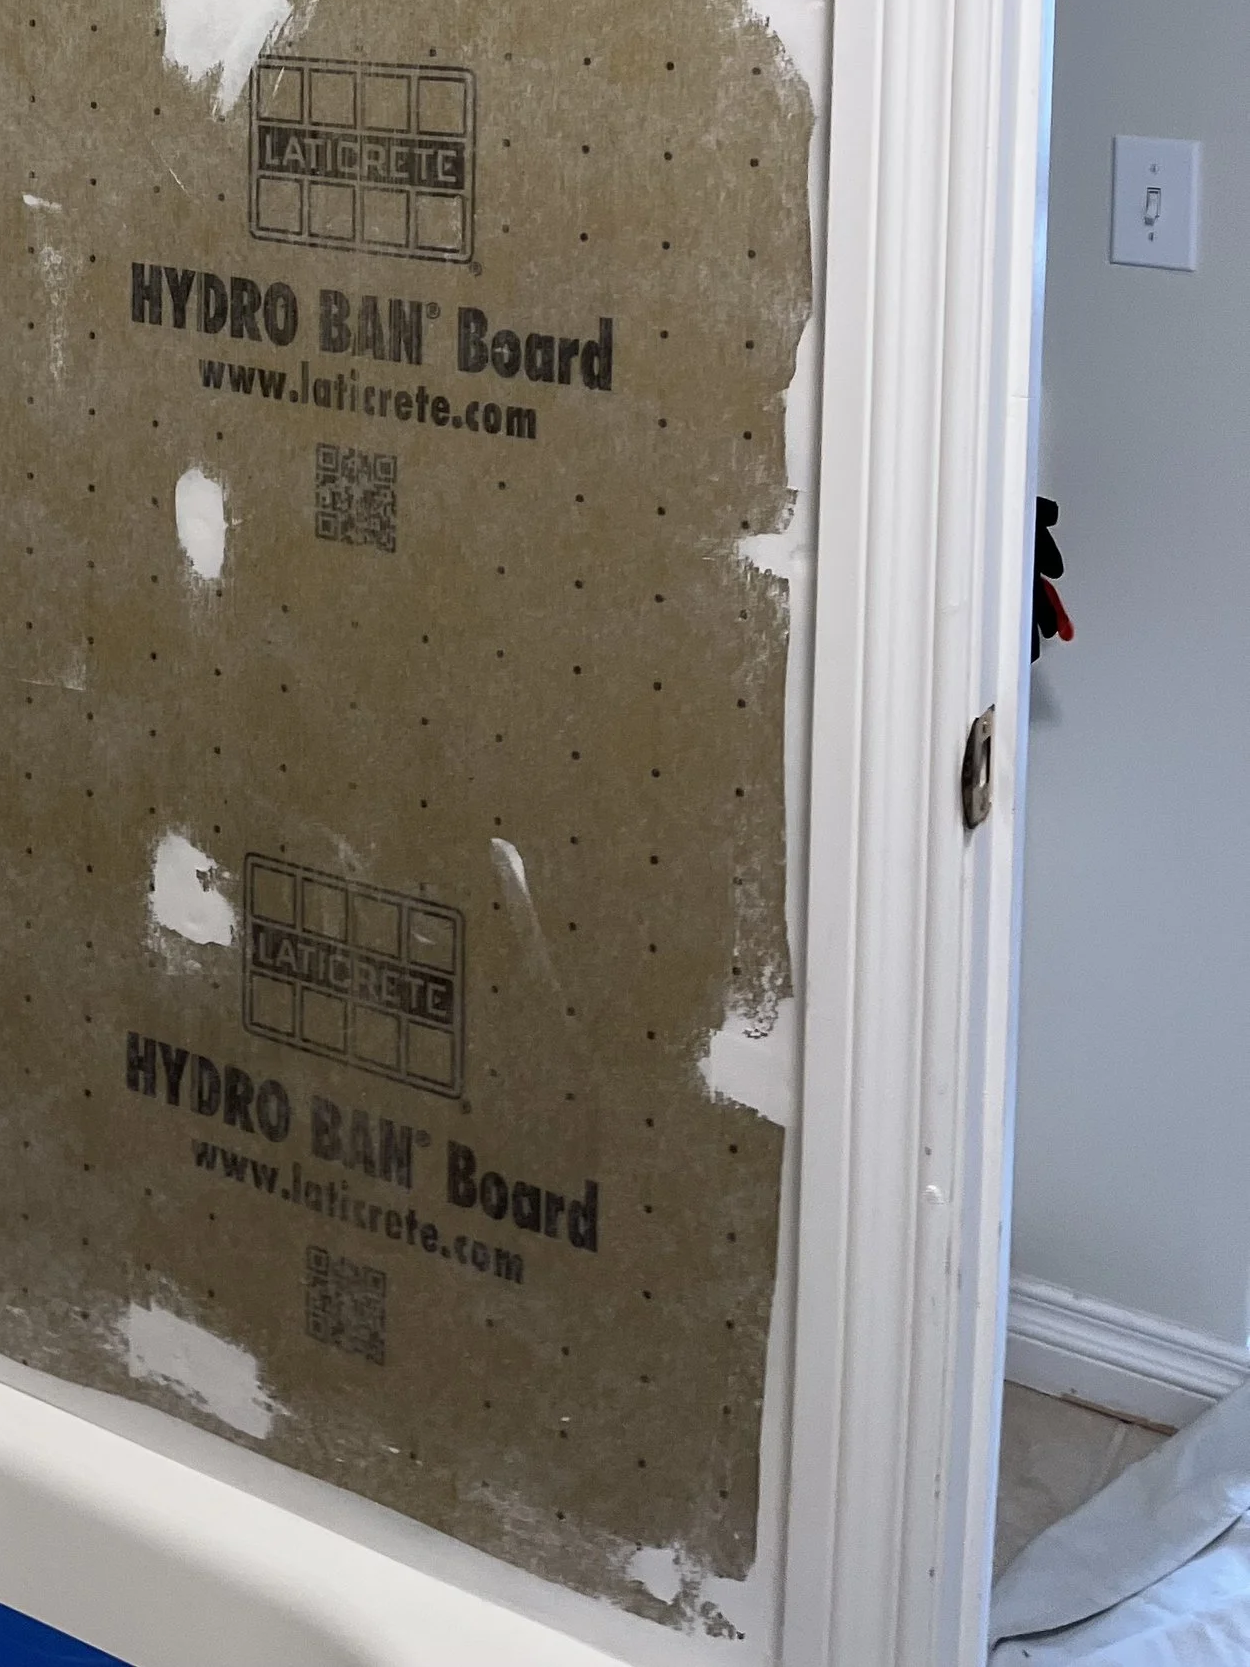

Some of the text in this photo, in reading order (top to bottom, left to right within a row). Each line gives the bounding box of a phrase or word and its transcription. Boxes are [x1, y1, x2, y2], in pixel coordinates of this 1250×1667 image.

[264, 133, 459, 183] LATICRETE
[131, 261, 298, 347] HYDRO
[458, 306, 613, 392] Board
[199, 359, 537, 439] www.laticrete.com
[257, 931, 449, 1018] LATICRETE
[126, 1030, 291, 1143] HYDRO
[448, 1139, 599, 1254] Board
[192, 1137, 525, 1286] www.laticrete.com
